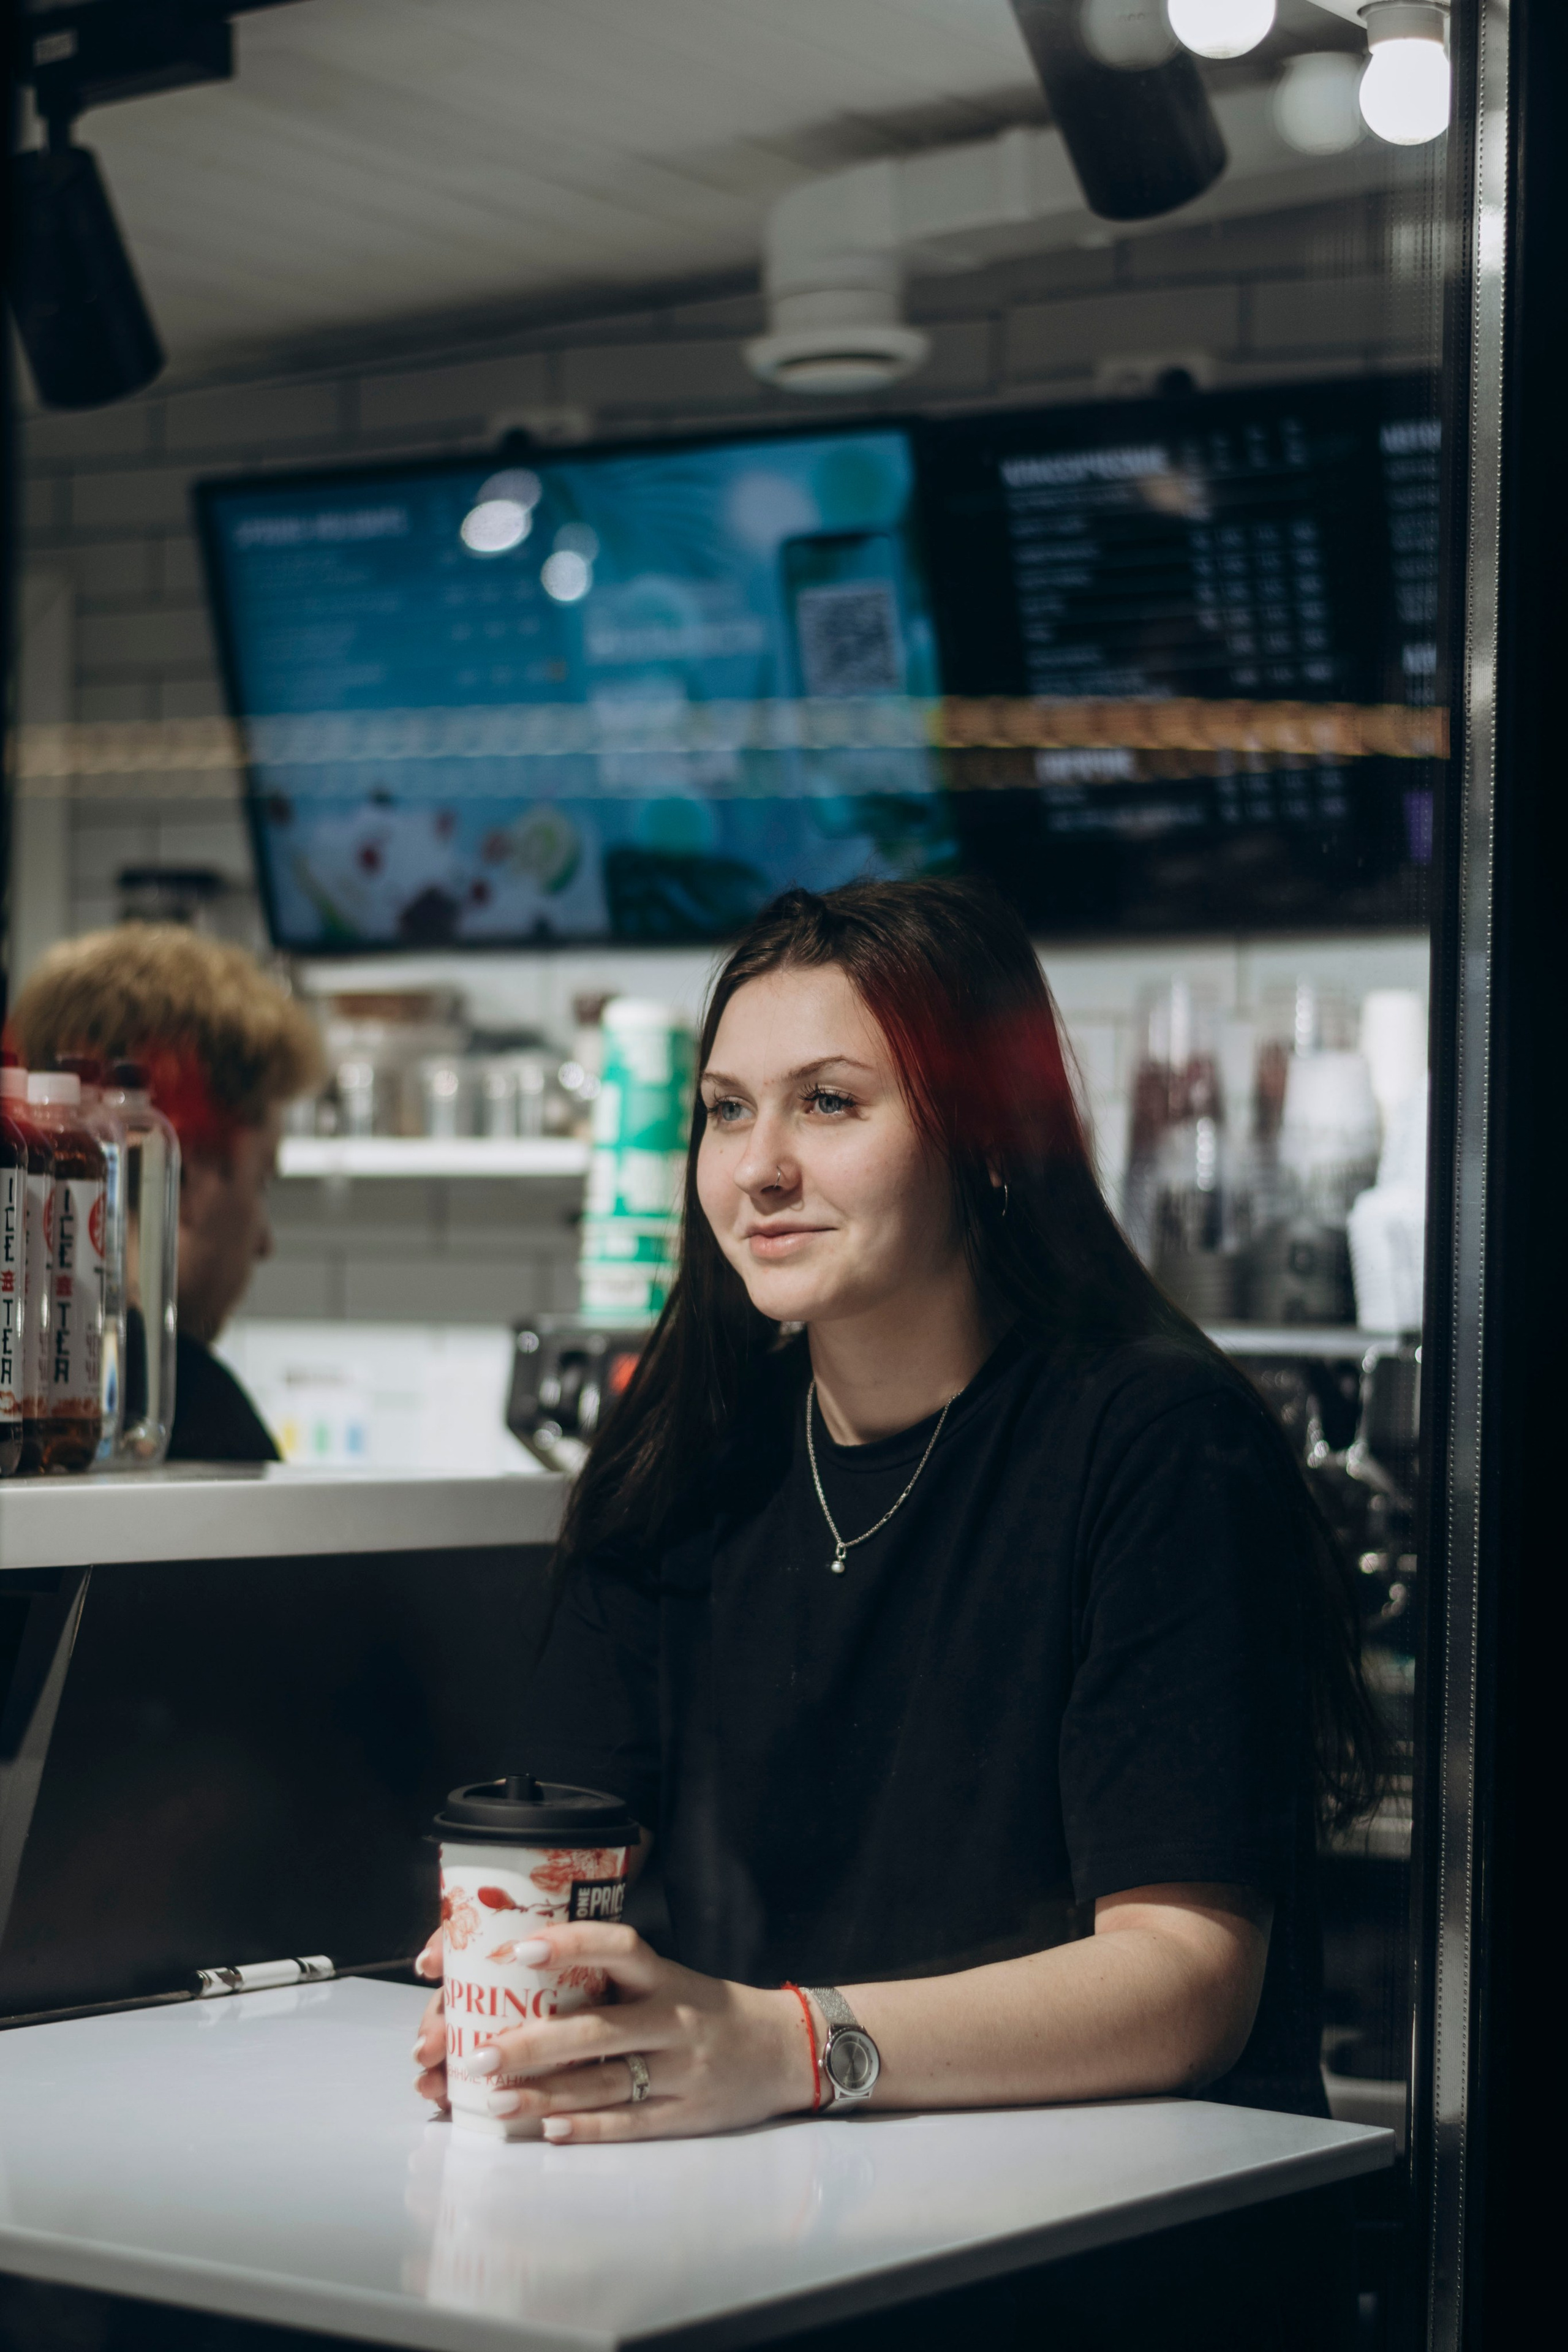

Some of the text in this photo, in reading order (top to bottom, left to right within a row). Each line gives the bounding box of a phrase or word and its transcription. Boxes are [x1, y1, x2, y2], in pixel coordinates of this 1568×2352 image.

[1, 1177, 15, 1384] ICE TEA
[55, 1188, 74, 1384] ICE TEA
[576, 1882, 625, 1918] ONE PRIC
[445, 1975, 558, 2019] SPRING
